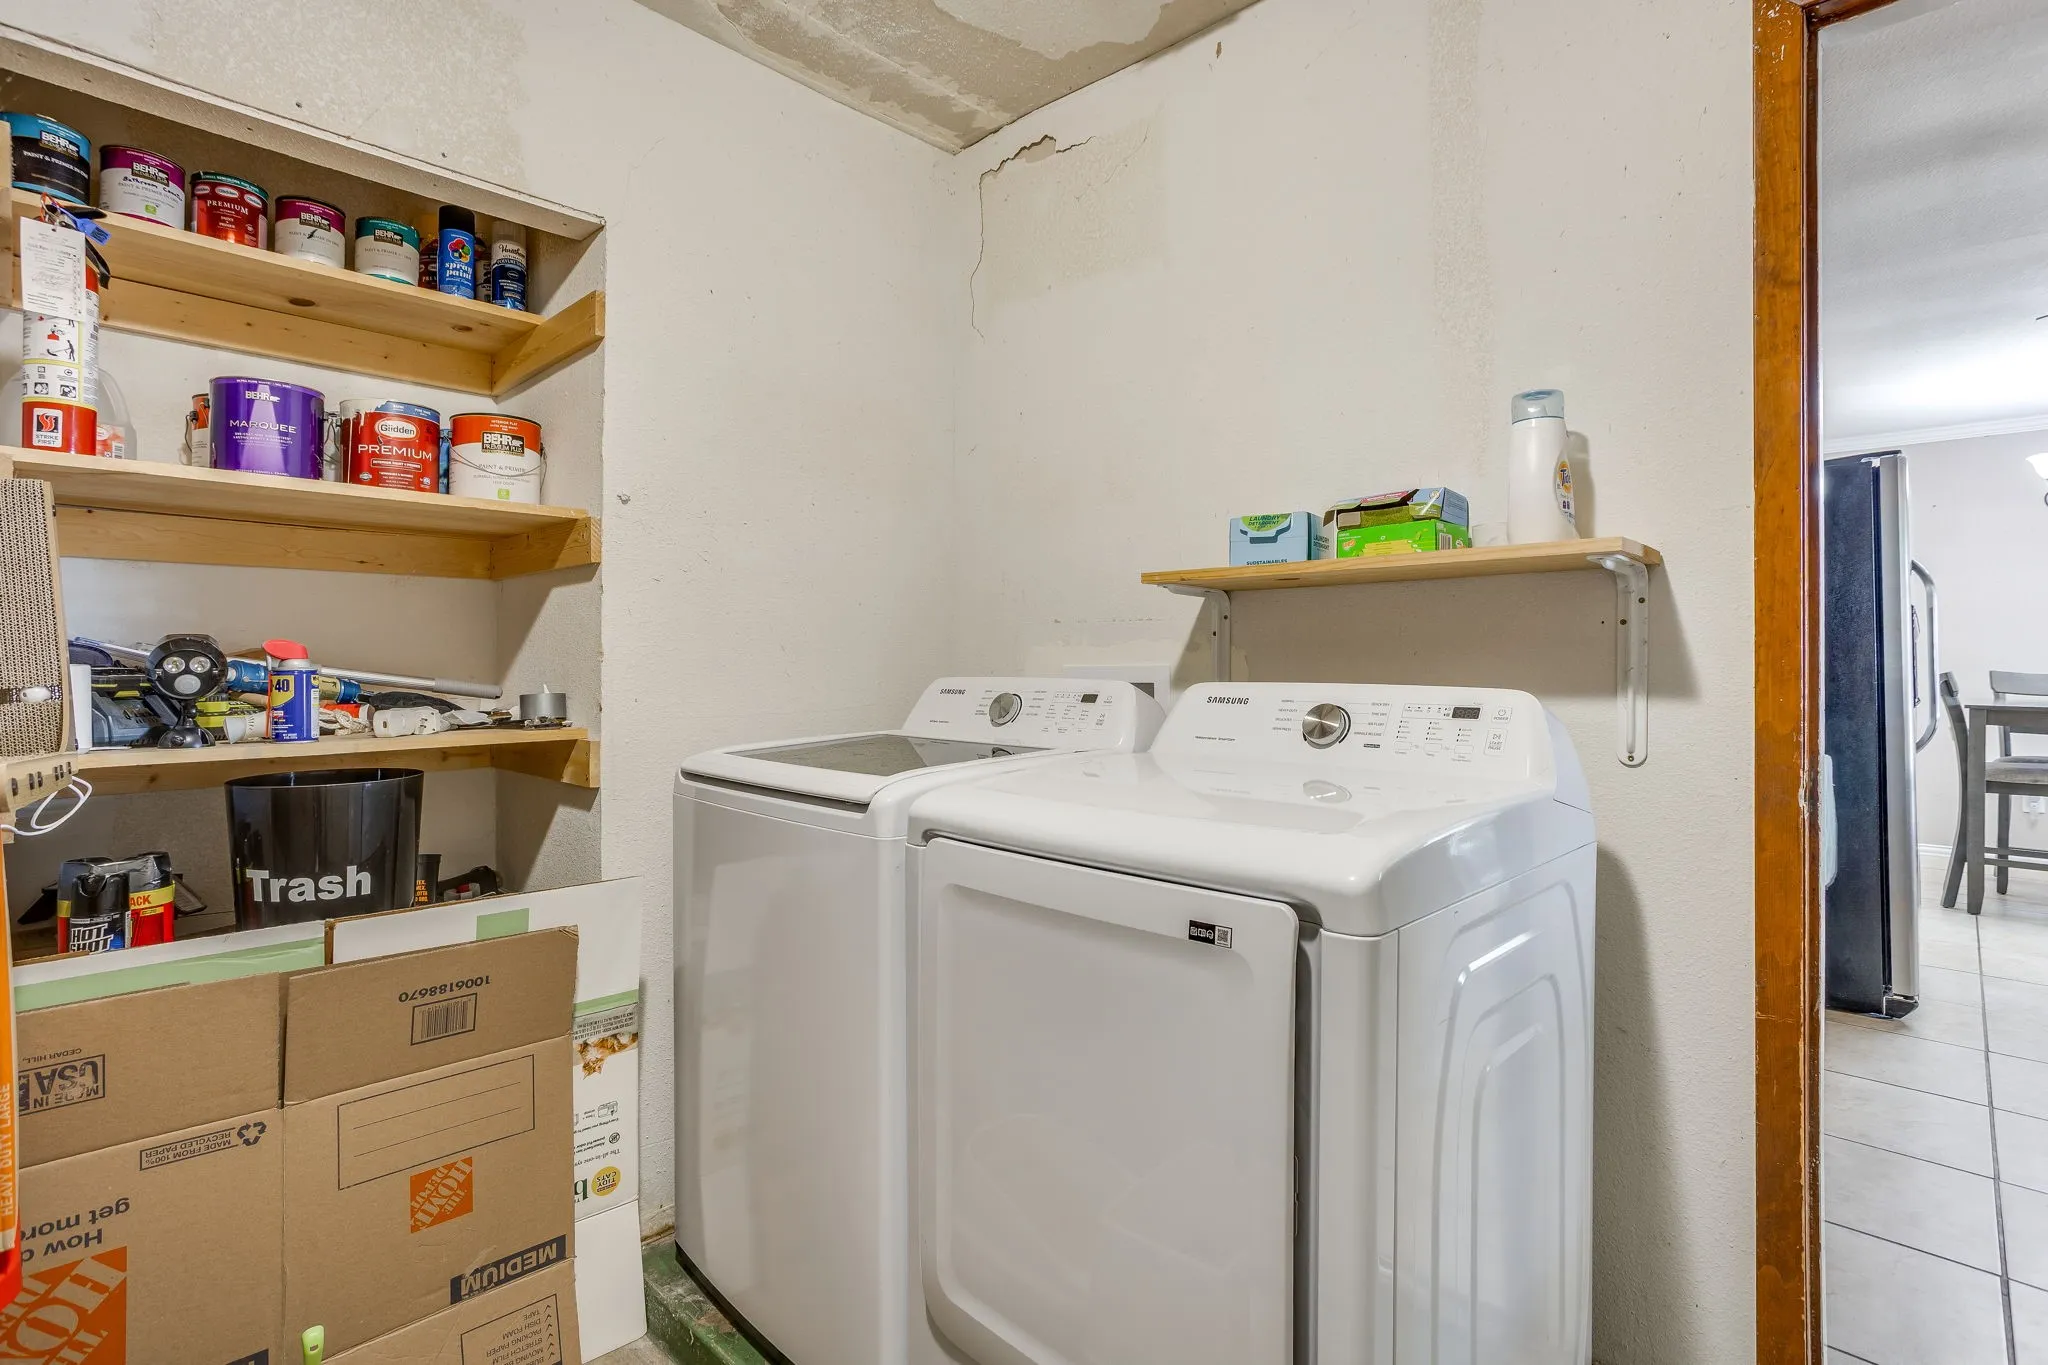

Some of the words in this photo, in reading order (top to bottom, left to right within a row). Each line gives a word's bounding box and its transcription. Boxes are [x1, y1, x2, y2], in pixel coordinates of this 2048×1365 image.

[41, 131, 70, 149] BEHR
[133, 162, 158, 176] BEHR
[207, 200, 249, 215] PREMIUM
[301, 212, 322, 223] BEHR
[375, 229, 394, 238] BEHR
[445, 262, 472, 275] spray
[446, 269, 472, 280] paint
[245, 391, 269, 401] BEHR
[230, 420, 297, 434] MARQUEE
[380, 424, 415, 435] Glidden
[483, 433, 512, 446] BEHR
[358, 444, 432, 461] PREMIUM
[510, 445, 522, 453] PLUS
[1206, 696, 1250, 705] SAMSUNG
[246, 866, 371, 902] Trash
[130, 895, 152, 907] ACK
[71, 923, 109, 943] HOT
[71, 934, 114, 953] SHOT
[399, 975, 491, 1003] 1006188670
[22, 1055, 47, 1064] HILL,
[49, 1048, 82, 1060] CEDAR
[34, 1061, 98, 1096] USA
[0, 1083, 11, 1128] LARGE
[34, 1096, 49, 1109] IN
[180, 1131, 231, 1147] RECYCLED
[204, 1139, 231, 1149] MADE
[0, 1133, 13, 1169] DUTY
[145, 1143, 178, 1159] PAPER
[173, 1147, 202, 1159] FROM
[145, 1154, 171, 1166] 100%
[597, 1171, 617, 1182] CATS
[598, 1177, 615, 1188] TIDY
[0, 1174, 13, 1216] HEAVY
[411, 1166, 449, 1211] DEPOT
[411, 1160, 472, 1228] HOME
[442, 1189, 466, 1215] THE
[88, 1197, 130, 1225] get
[43, 1228, 103, 1257] How
[460, 1240, 558, 1298] MEDIUM
[523, 1309, 540, 1321] TAPE
[524, 1318, 541, 1330] DISH
[502, 1326, 523, 1340] FOAM
[511, 1328, 542, 1346] PACKING
[486, 1341, 510, 1357] PAPER
[510, 1337, 543, 1356] STRETCH
[492, 1353, 510, 1365] FILM
[515, 1347, 543, 1363] MOVING
